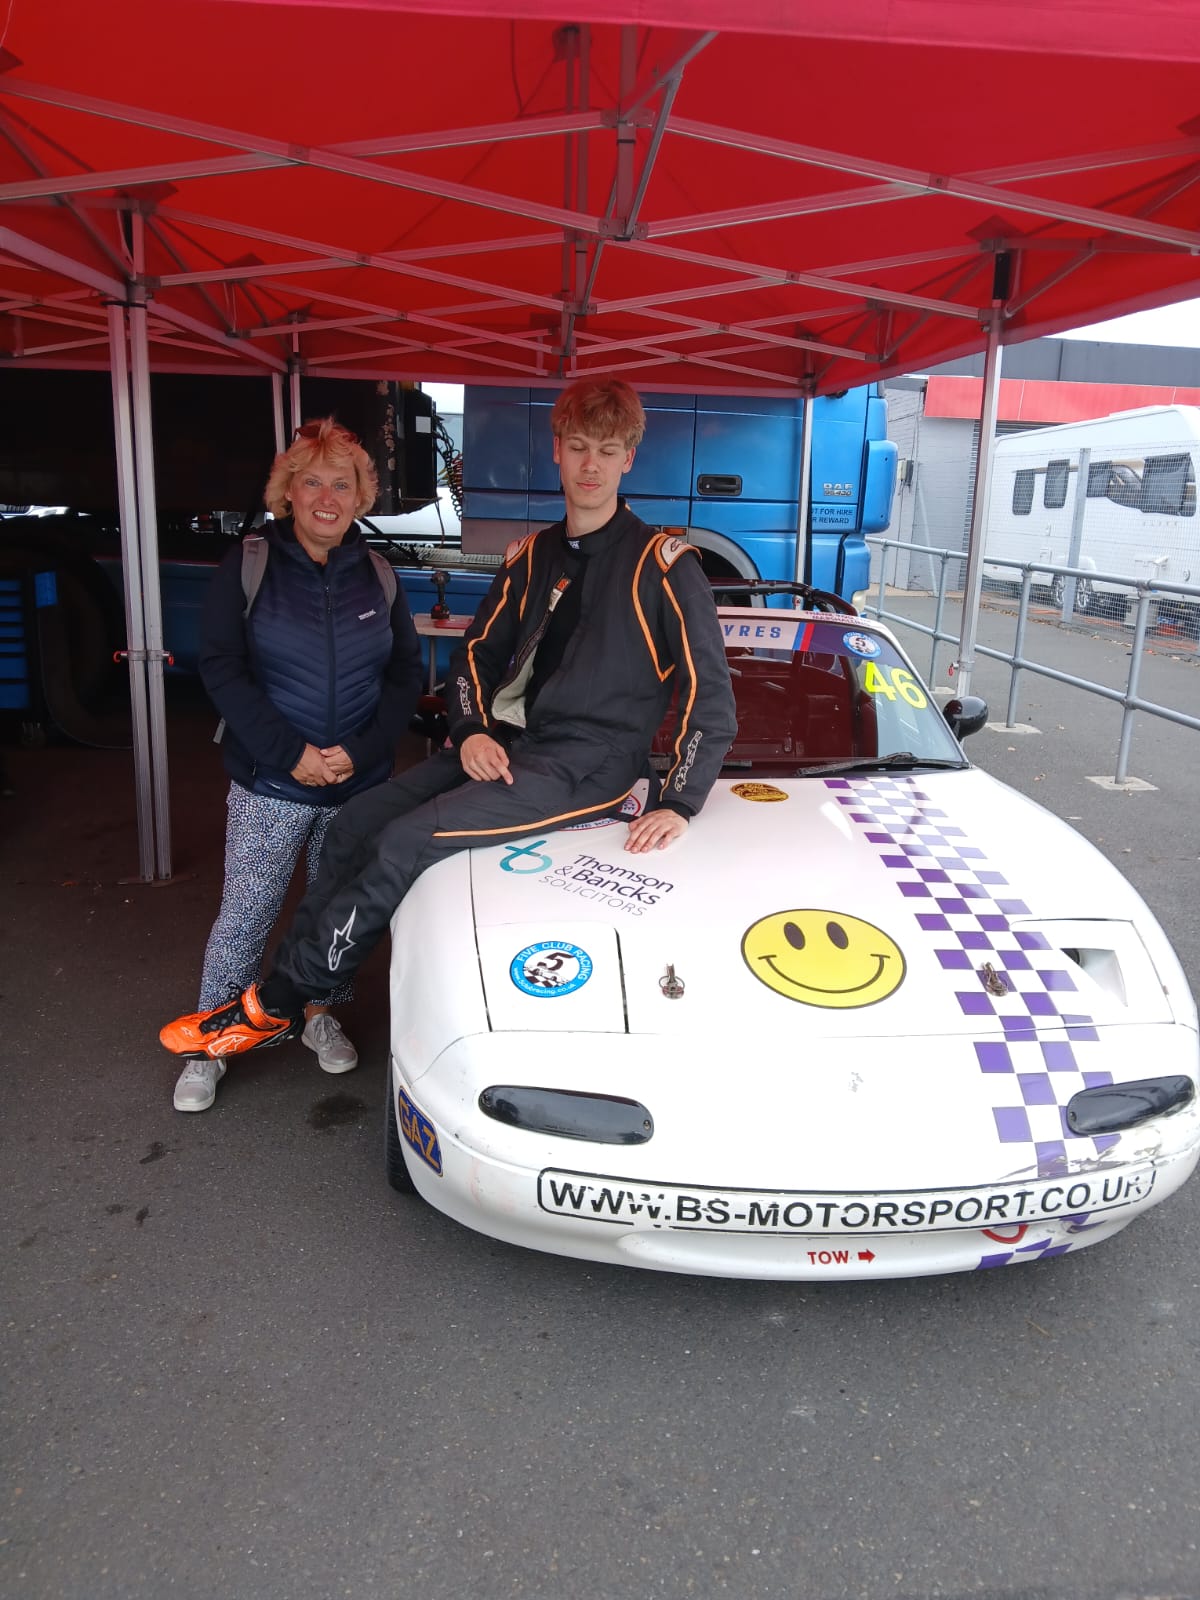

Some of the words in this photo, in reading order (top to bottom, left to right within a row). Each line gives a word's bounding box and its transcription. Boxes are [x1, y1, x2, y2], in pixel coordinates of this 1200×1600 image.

[819, 517, 850, 525] REWARD
[820, 508, 834, 516] FOR
[864, 661, 928, 710] 46
[554, 865, 573, 876] &
[572, 868, 661, 905] Bancks
[573, 854, 674, 893] Thomson
[539, 874, 648, 917] SOLICITORS
[517, 944, 540, 962] FIVE
[541, 942, 573, 951] CLUB
[574, 949, 592, 981] RACING
[545, 952, 575, 971] 5
[399, 1096, 440, 1169] GAZ
[807, 1250, 850, 1265] TOW
